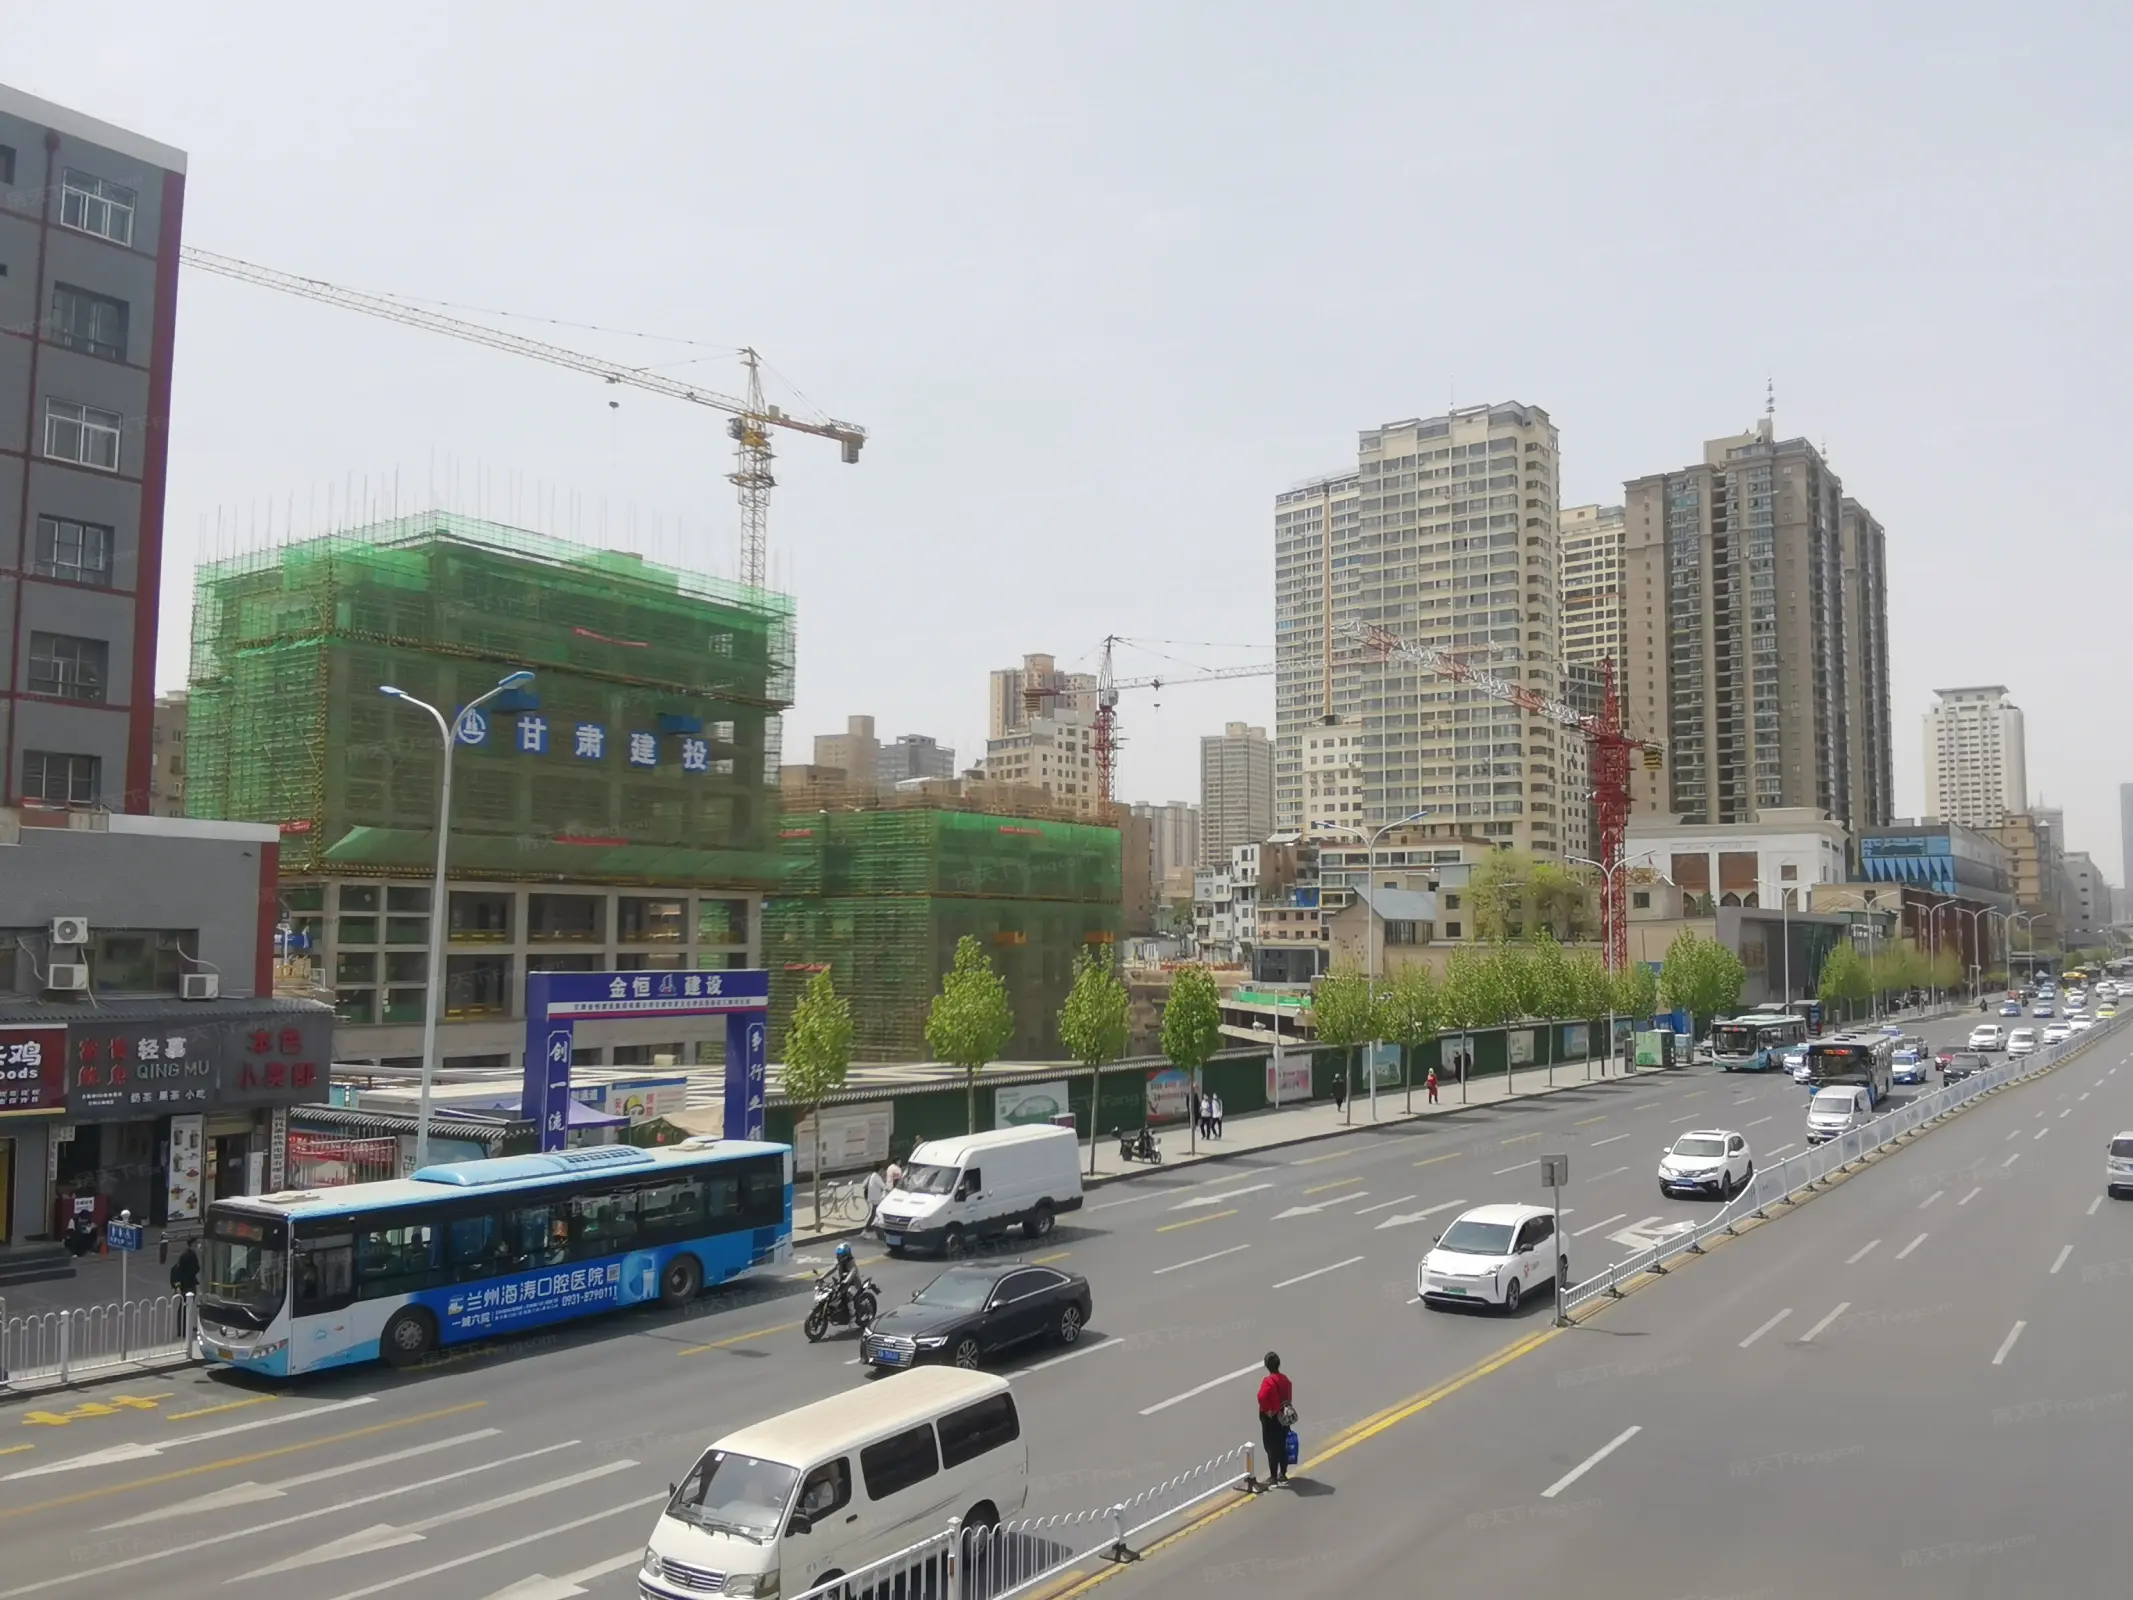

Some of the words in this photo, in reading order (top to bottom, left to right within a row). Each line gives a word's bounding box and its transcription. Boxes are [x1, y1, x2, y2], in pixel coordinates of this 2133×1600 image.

[518, 716, 709, 771] 甘肃建投
[609, 976, 651, 998] 金恒
[684, 975, 723, 997] 建设
[137, 1062, 180, 1080] QING
[184, 1060, 210, 1077] MU
[466, 1266, 604, 1312] 兰州海涛口腔医院
